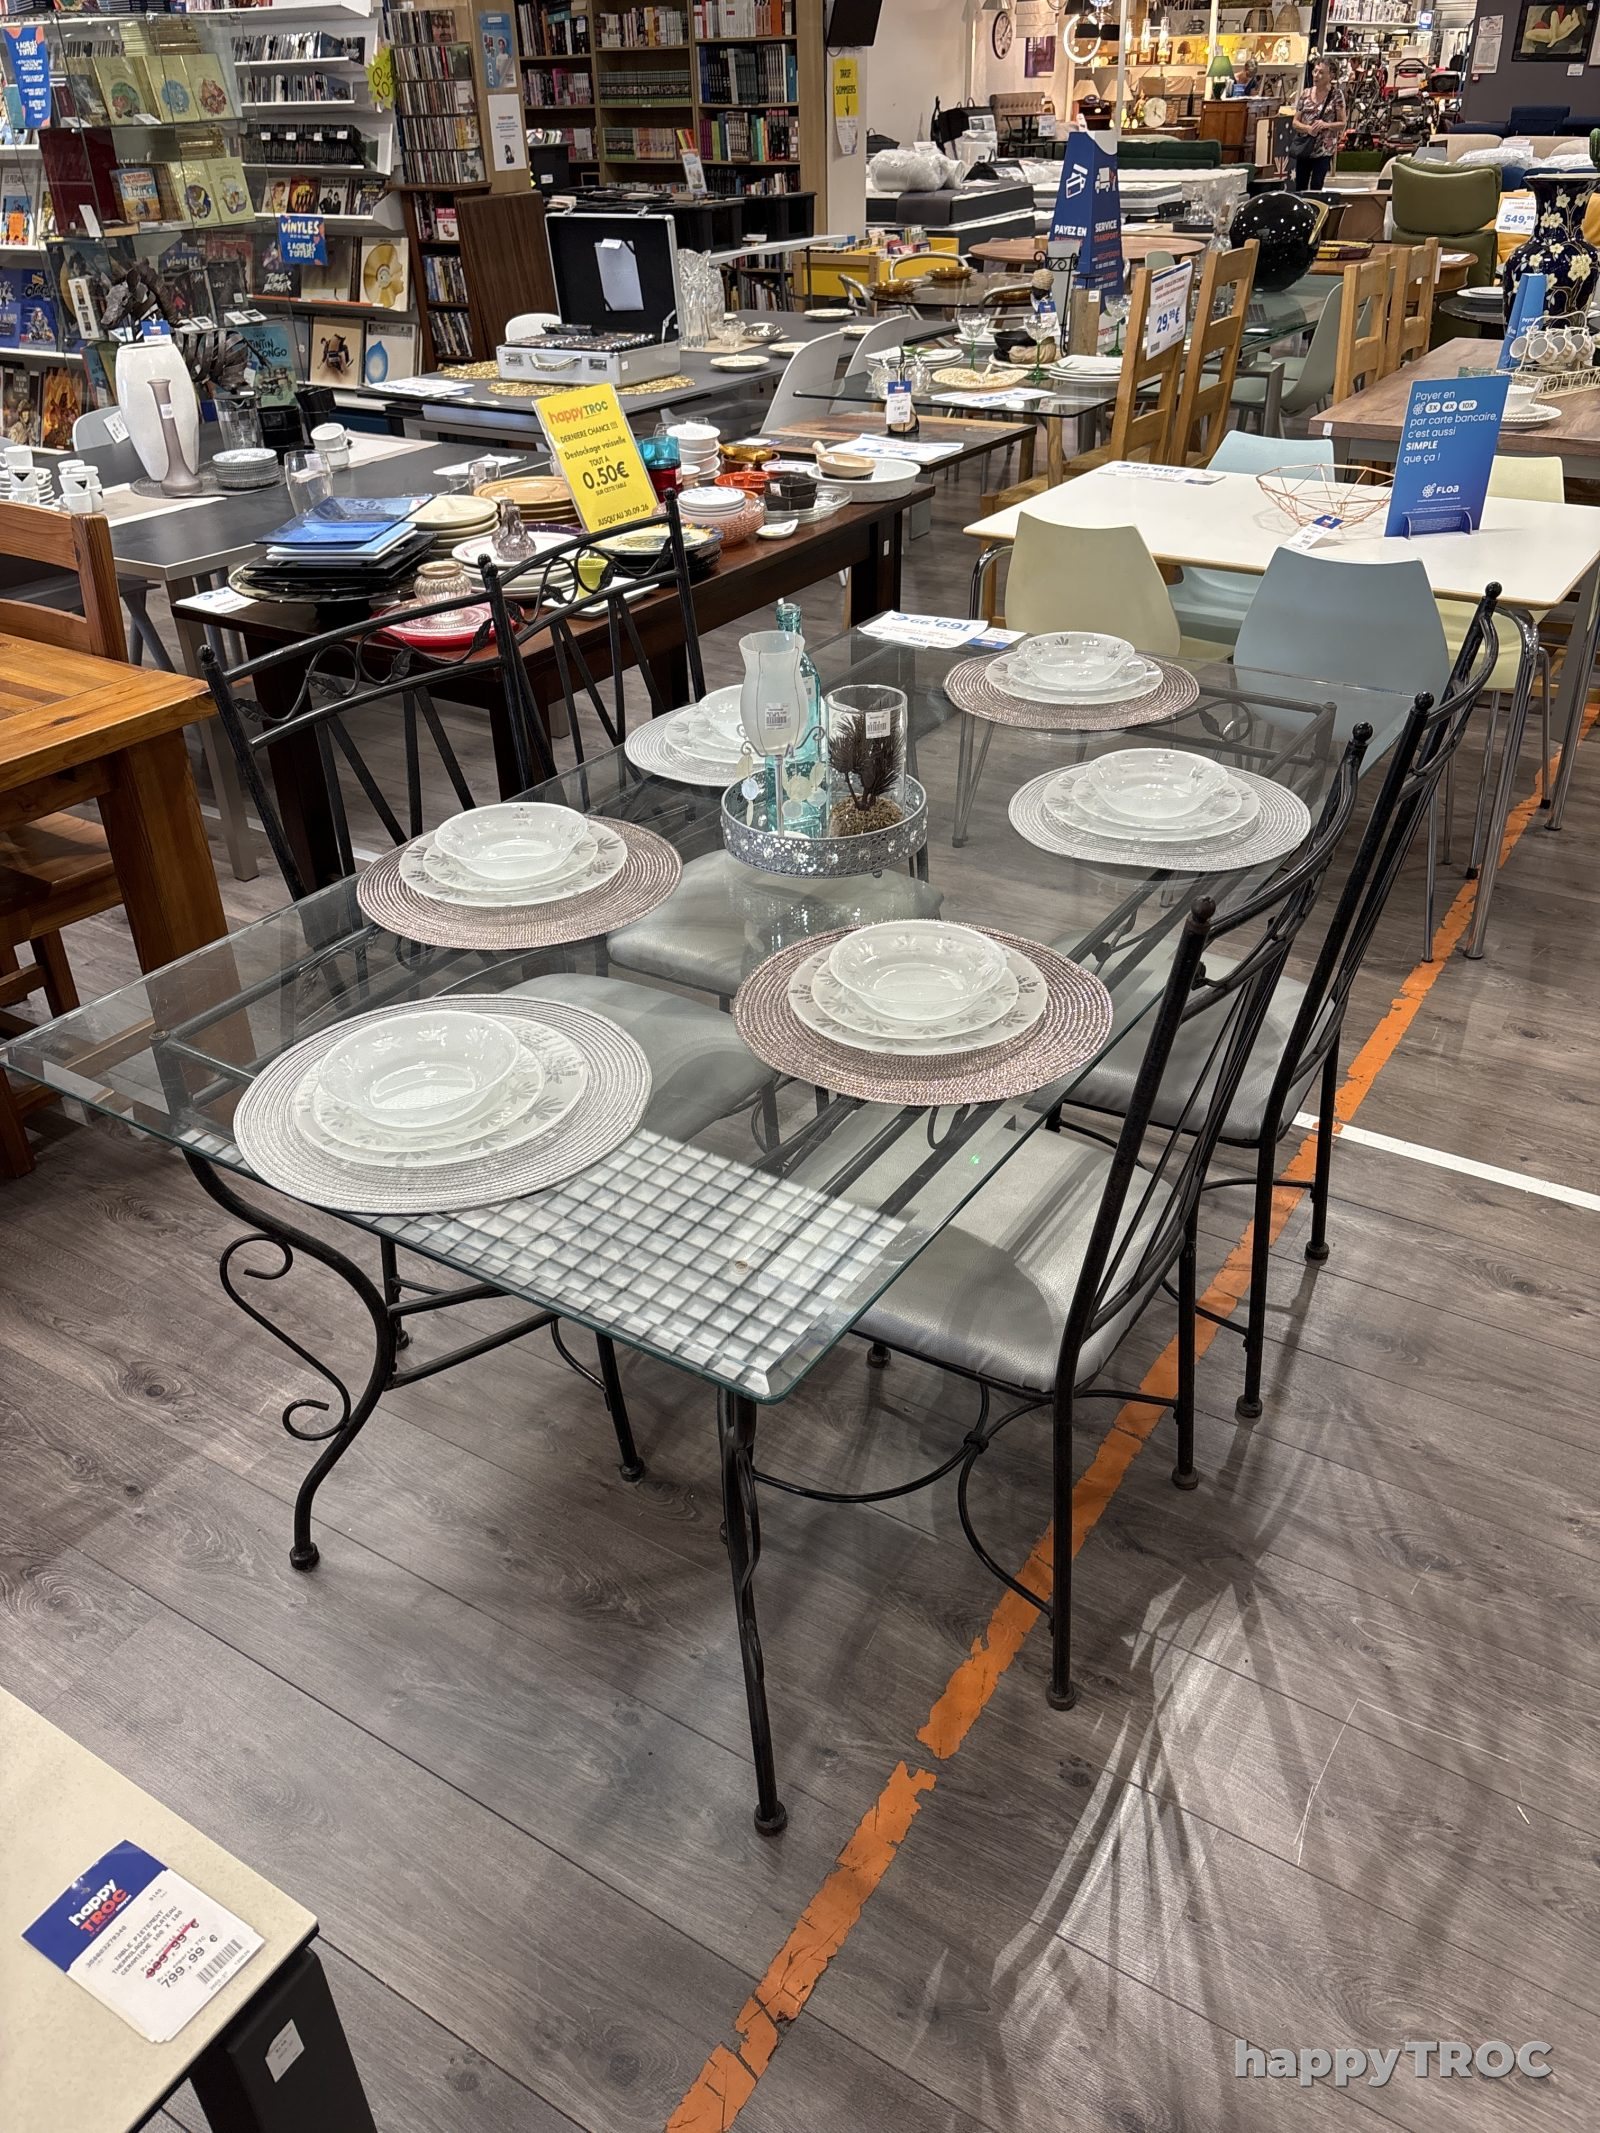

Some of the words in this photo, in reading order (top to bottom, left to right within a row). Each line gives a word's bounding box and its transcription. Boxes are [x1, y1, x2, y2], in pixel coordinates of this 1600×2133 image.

[1054, 224, 1076, 236] PAYEZ
[1077, 226, 1087, 237] EN
[1095, 219, 1118, 232] SERVICE
[257, 347, 287, 358] ONGO
[1415, 391, 1442, 401] Payer
[1443, 391, 1456, 399] en
[1410, 418, 1428, 428] par
[1428, 415, 1453, 425] carte
[1455, 413, 1498, 423] bancaire,
[1408, 429, 1430, 439] c'est
[1432, 426, 1457, 437] aussi
[565, 444, 601, 460] Destockage
[602, 436, 627, 450] vaisselle
[1405, 440, 1438, 451] SIMPLE
[589, 456, 604, 467] TOUT
[1403, 455, 1421, 466] que
[1424, 454, 1435, 465] ça
[582, 461, 630, 489] 0.50€
[68, 1877, 119, 1927] happy
[79, 1886, 128, 1935] TROC
[151, 1904, 177, 1931] PLATEAU
[113, 1941, 133, 1962] TABLE
[132, 1908, 164, 1941] PIETEMENT
[119, 1942, 152, 1976] CERAMIQUE
